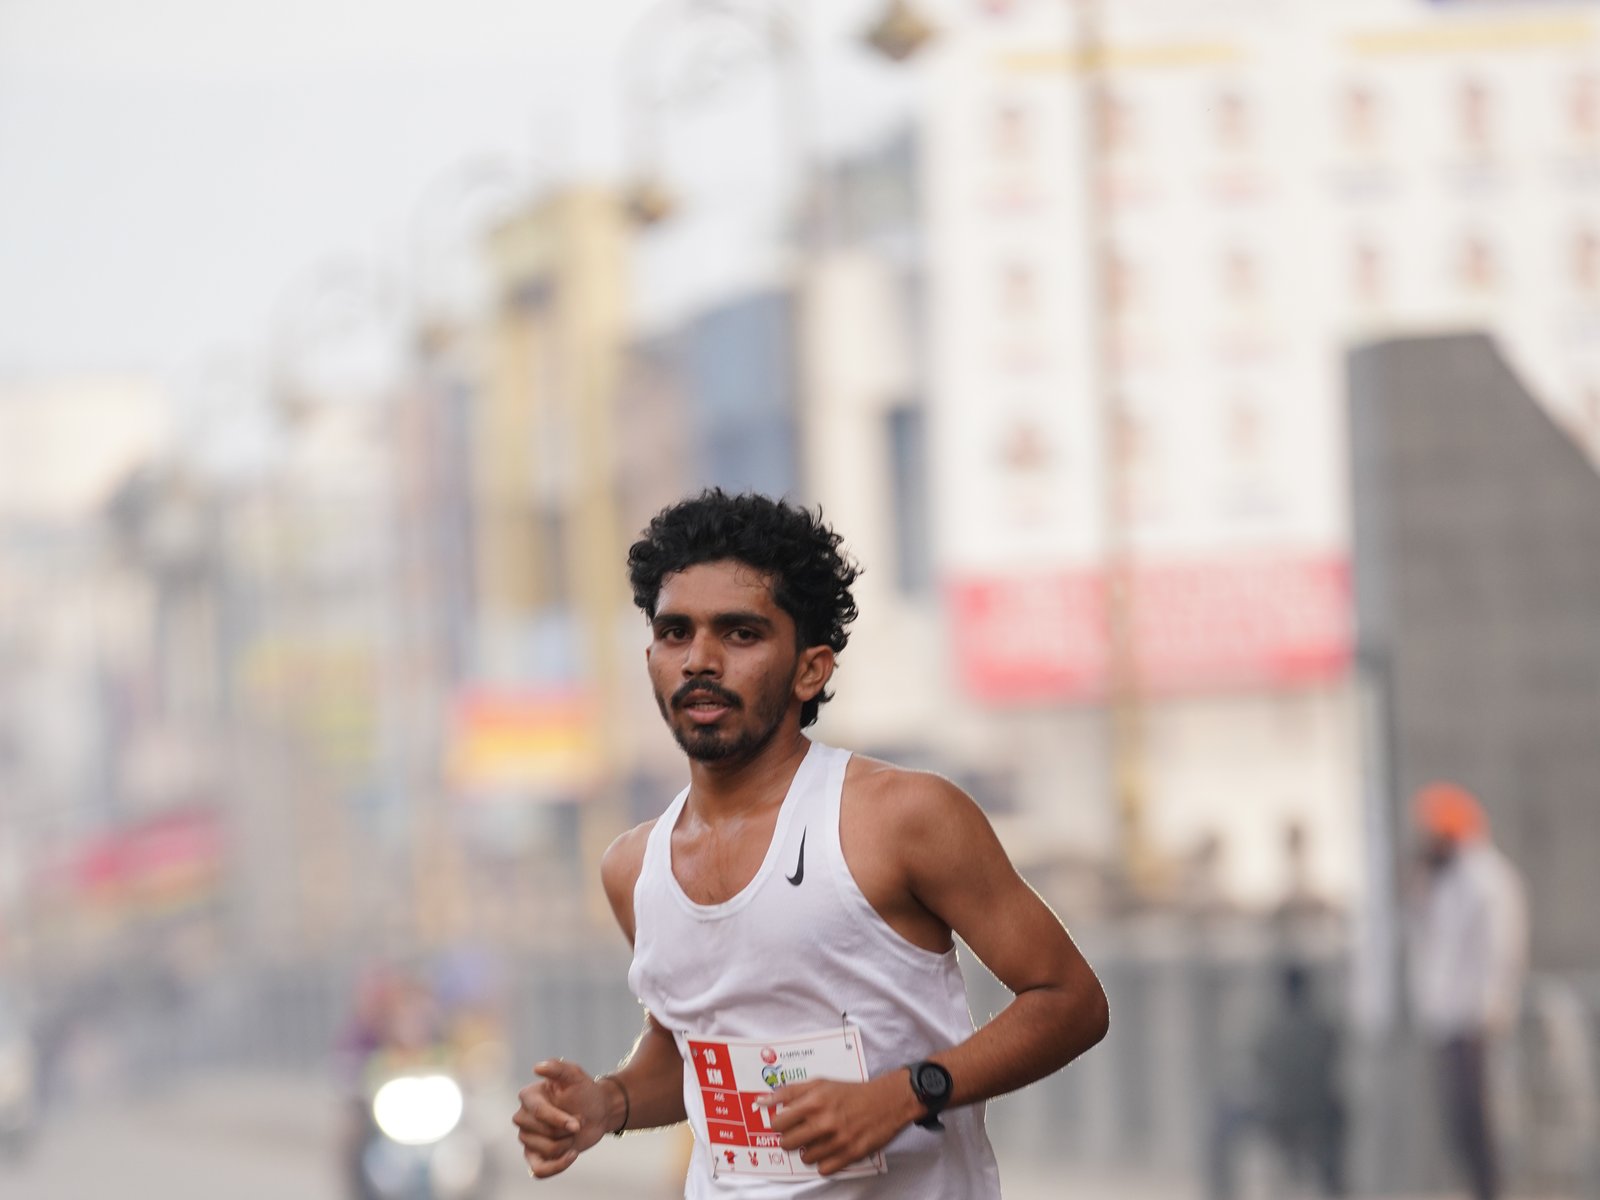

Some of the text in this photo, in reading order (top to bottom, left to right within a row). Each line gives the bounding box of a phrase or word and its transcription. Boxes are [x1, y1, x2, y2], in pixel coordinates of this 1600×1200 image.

[703, 1048, 717, 1065] 10
[706, 1068, 723, 1085] KM
[719, 1130, 734, 1139] MALE
